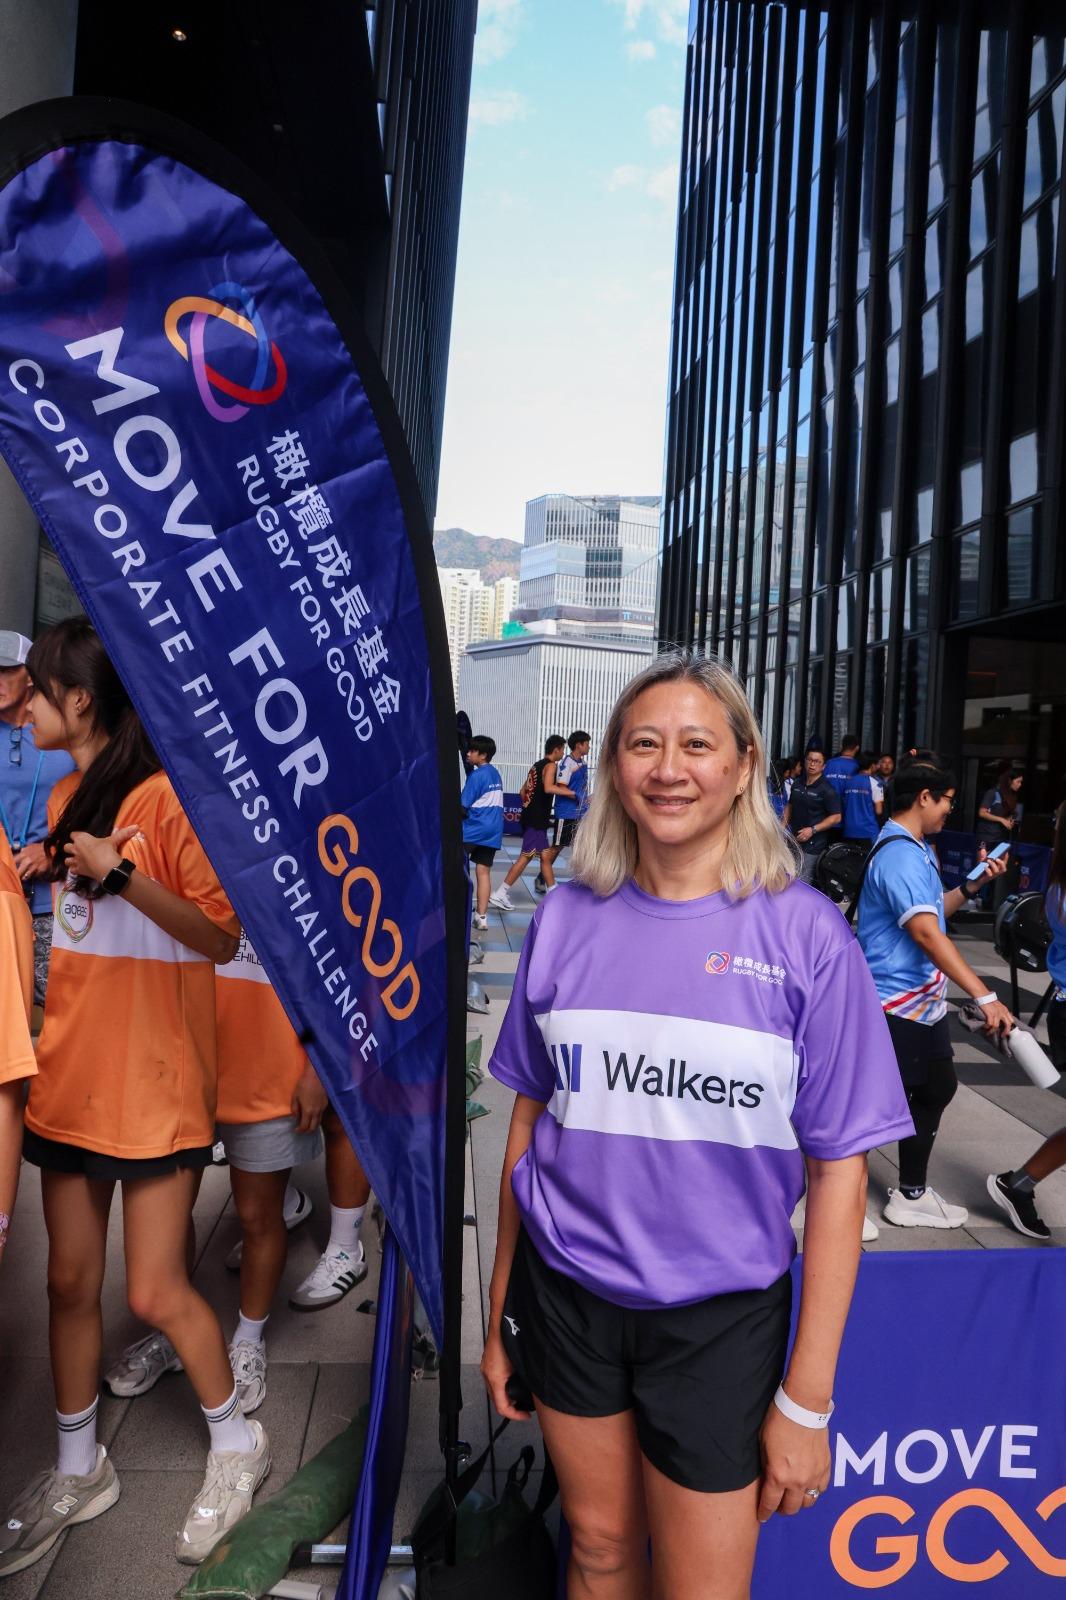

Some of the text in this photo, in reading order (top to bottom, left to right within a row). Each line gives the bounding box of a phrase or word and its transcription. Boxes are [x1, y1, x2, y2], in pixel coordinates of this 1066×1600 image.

[8, 358, 379, 1062] CORPORATE FITNESS CHALLENGE
[64, 326, 421, 1021] MOVE FOR GOOD
[236, 454, 374, 743] RUGBY FOR GOOD
[265, 429, 401, 724] 橄欖成長基金
[602, 1050, 765, 1109] Walkers
[732, 967, 755, 976] RUGBY
[833, 1424, 1039, 1487] MOVE
